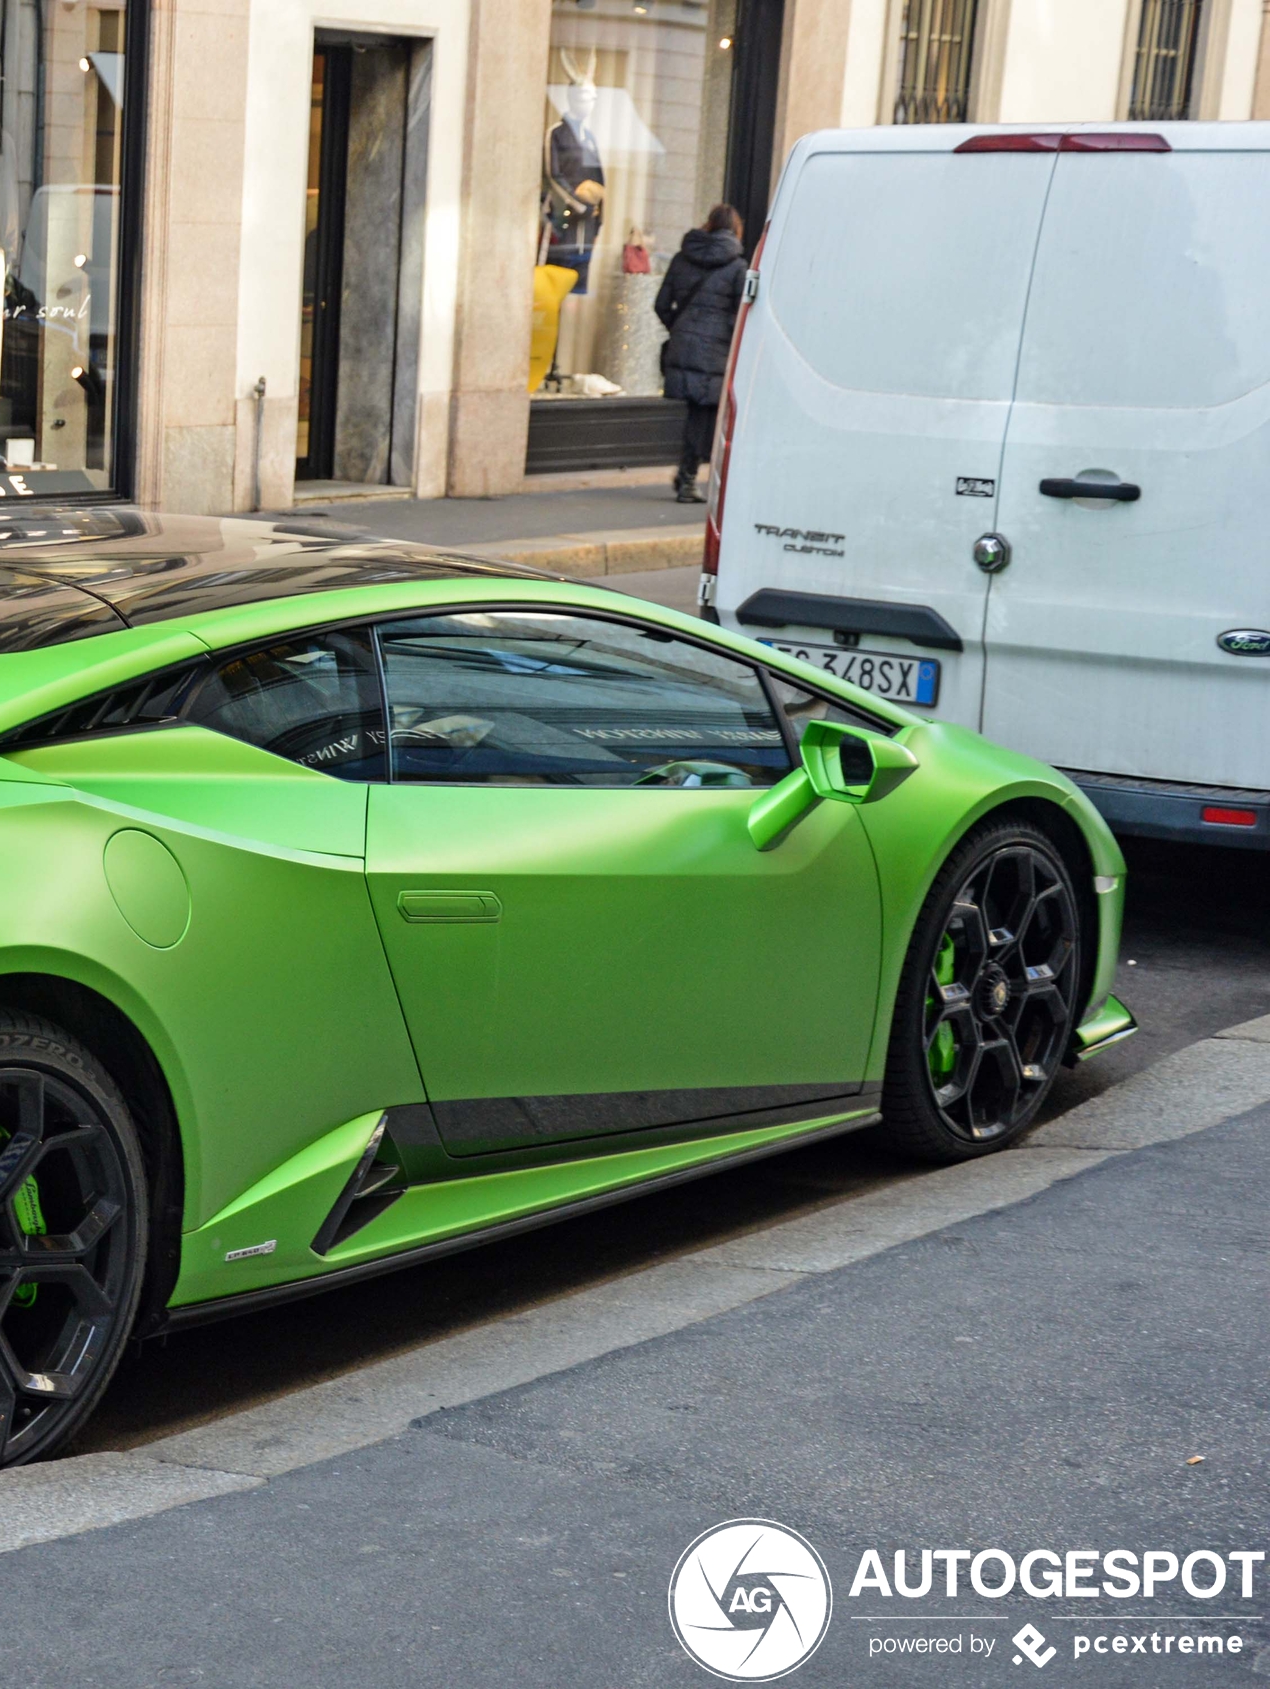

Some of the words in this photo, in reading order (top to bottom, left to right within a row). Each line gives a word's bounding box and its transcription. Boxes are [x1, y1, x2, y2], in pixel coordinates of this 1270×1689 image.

[36, 293, 92, 319] soul
[754, 523, 846, 544] TRANSIT
[783, 543, 845, 557] CUSTOM
[1230, 634, 1270, 650] Ford
[823, 652, 914, 697] 348SX
